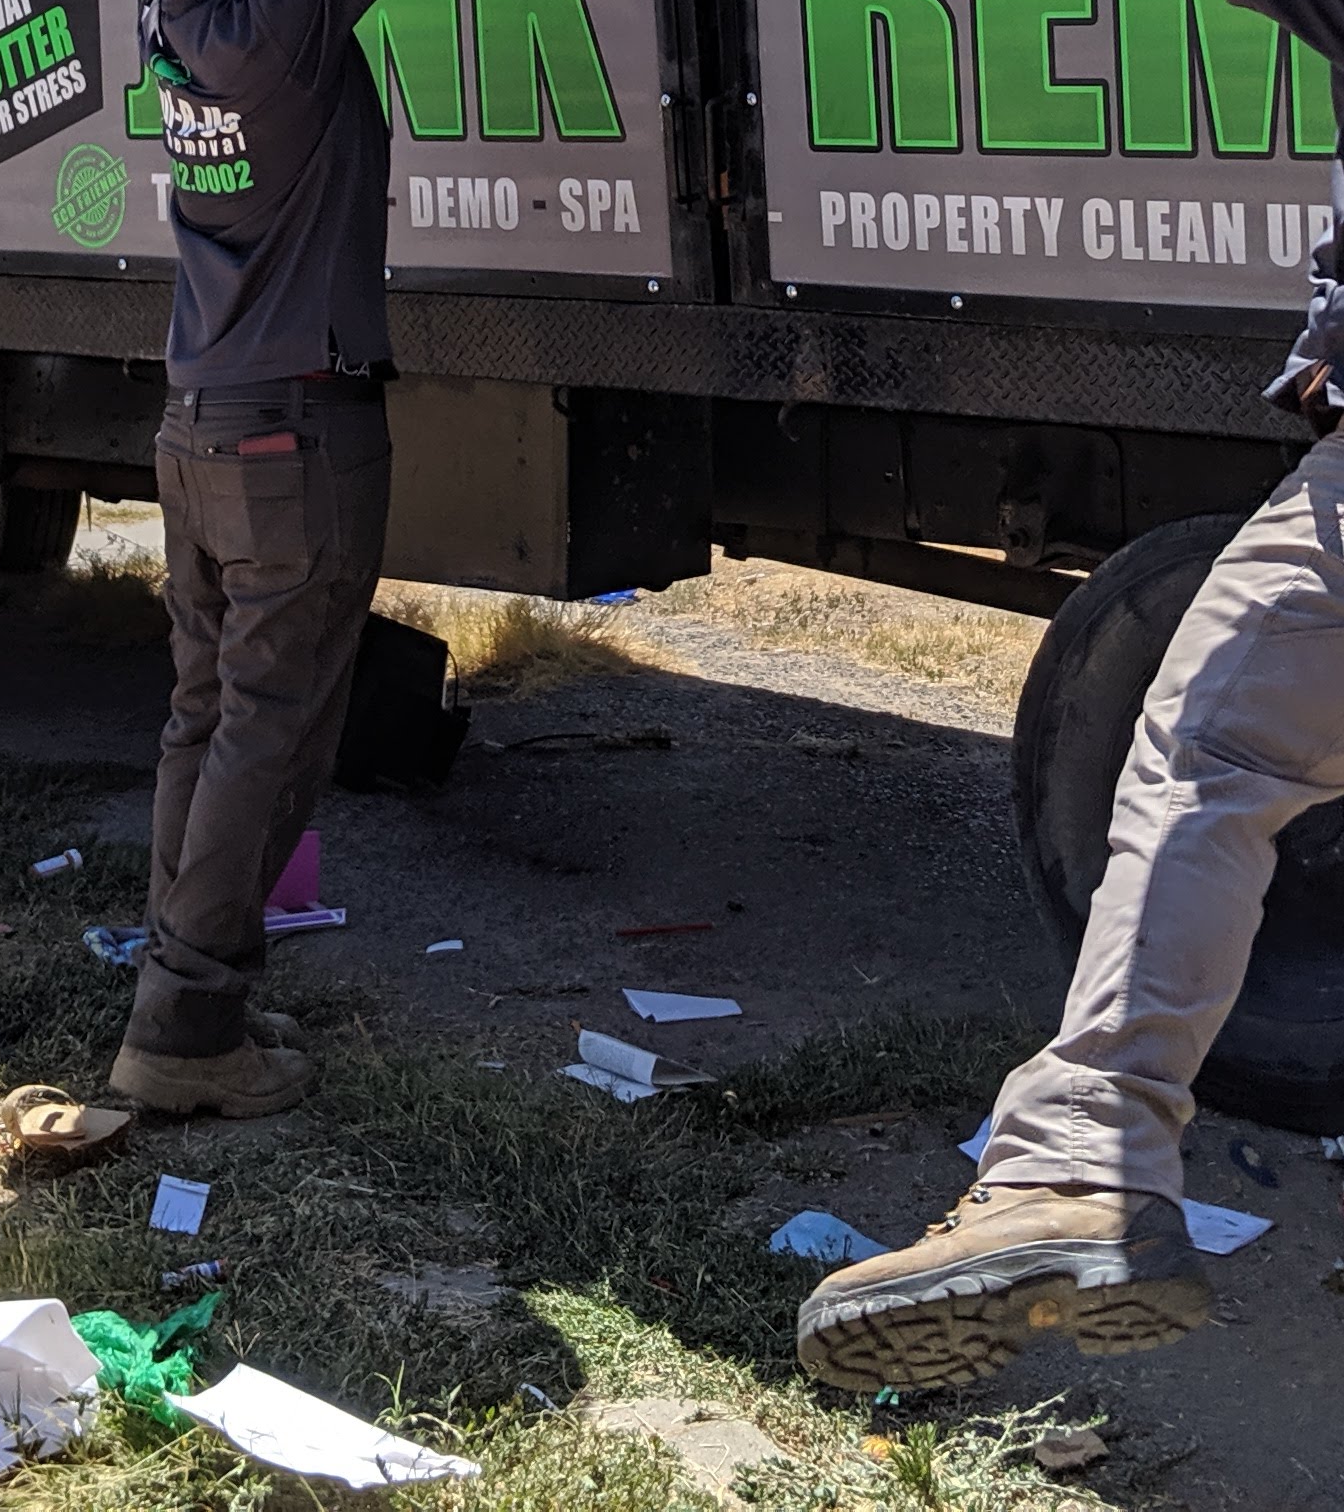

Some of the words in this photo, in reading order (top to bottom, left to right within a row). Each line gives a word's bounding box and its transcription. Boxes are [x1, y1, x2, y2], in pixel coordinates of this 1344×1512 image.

[12, 59, 86, 125] STRESS
[410, 178, 519, 231] DEMO
[560, 180, 641, 233] SPA
[820, 190, 1064, 258] PROPERTY
[1082, 199, 1248, 265] CLEAN
